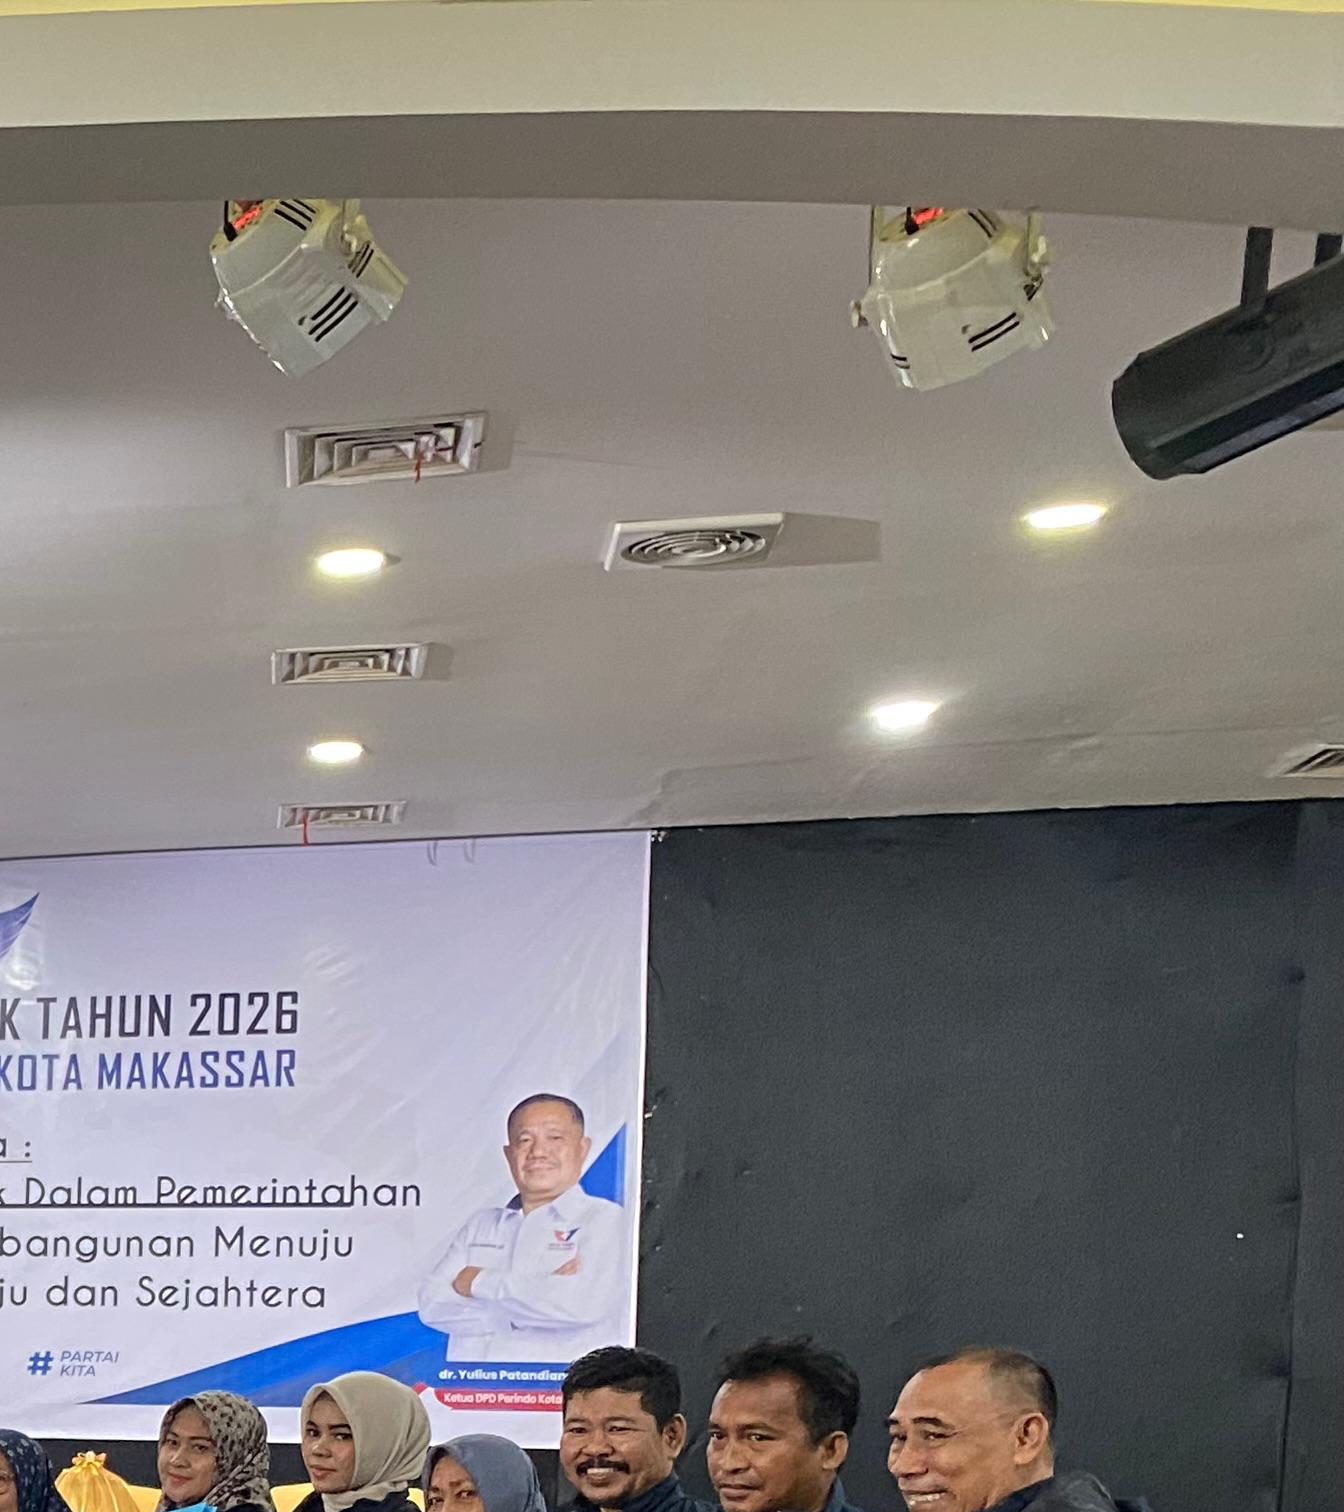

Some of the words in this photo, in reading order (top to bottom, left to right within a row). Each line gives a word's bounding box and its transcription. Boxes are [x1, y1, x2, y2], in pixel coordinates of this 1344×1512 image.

[36, 994, 173, 1041] TAHUN
[189, 991, 300, 1036] 2026
[96, 1049, 297, 1091] MAKASSAR
[23, 1177, 138, 1207] Dalam
[156, 1175, 422, 1208] Pemerintahan
[214, 1227, 355, 1261] Menuju
[45, 1276, 118, 1308] dan
[135, 1275, 327, 1311] Sejahtera
[60, 1351, 120, 1363] PARTAI
[60, 1365, 96, 1377] KITA
[438, 1370, 457, 1380] dr.
[458, 1370, 497, 1380] Yulius
[444, 1393, 474, 1403] Ketua
[476, 1394, 496, 1403] DPD
[499, 1394, 536, 1404] Perindo
